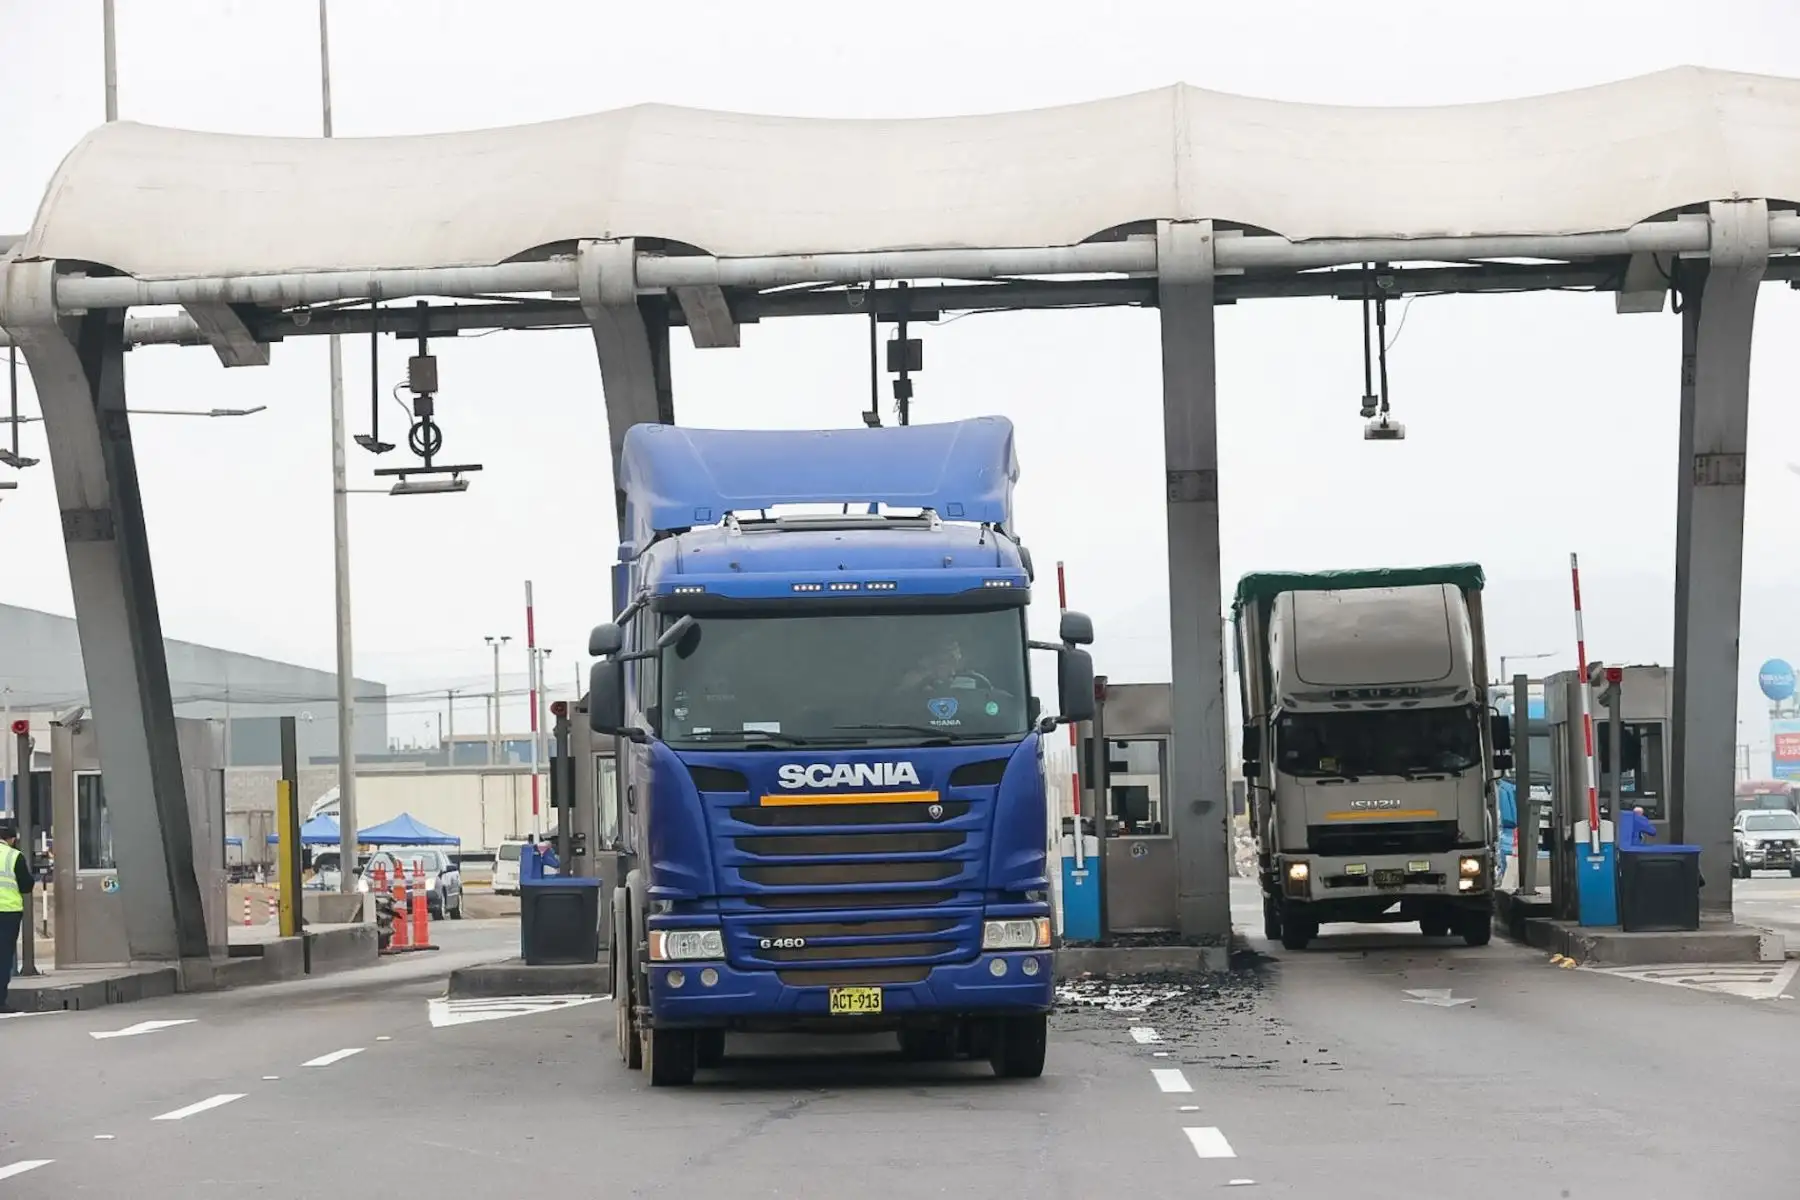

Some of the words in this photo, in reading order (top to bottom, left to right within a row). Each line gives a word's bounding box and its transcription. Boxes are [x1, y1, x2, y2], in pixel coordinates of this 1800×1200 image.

[778, 762, 920, 788] SCANIA
[1350, 799, 1401, 810] ISUZU
[760, 939, 771, 949] G
[773, 937, 805, 948] 460
[832, 993, 880, 1009] ACT-913
